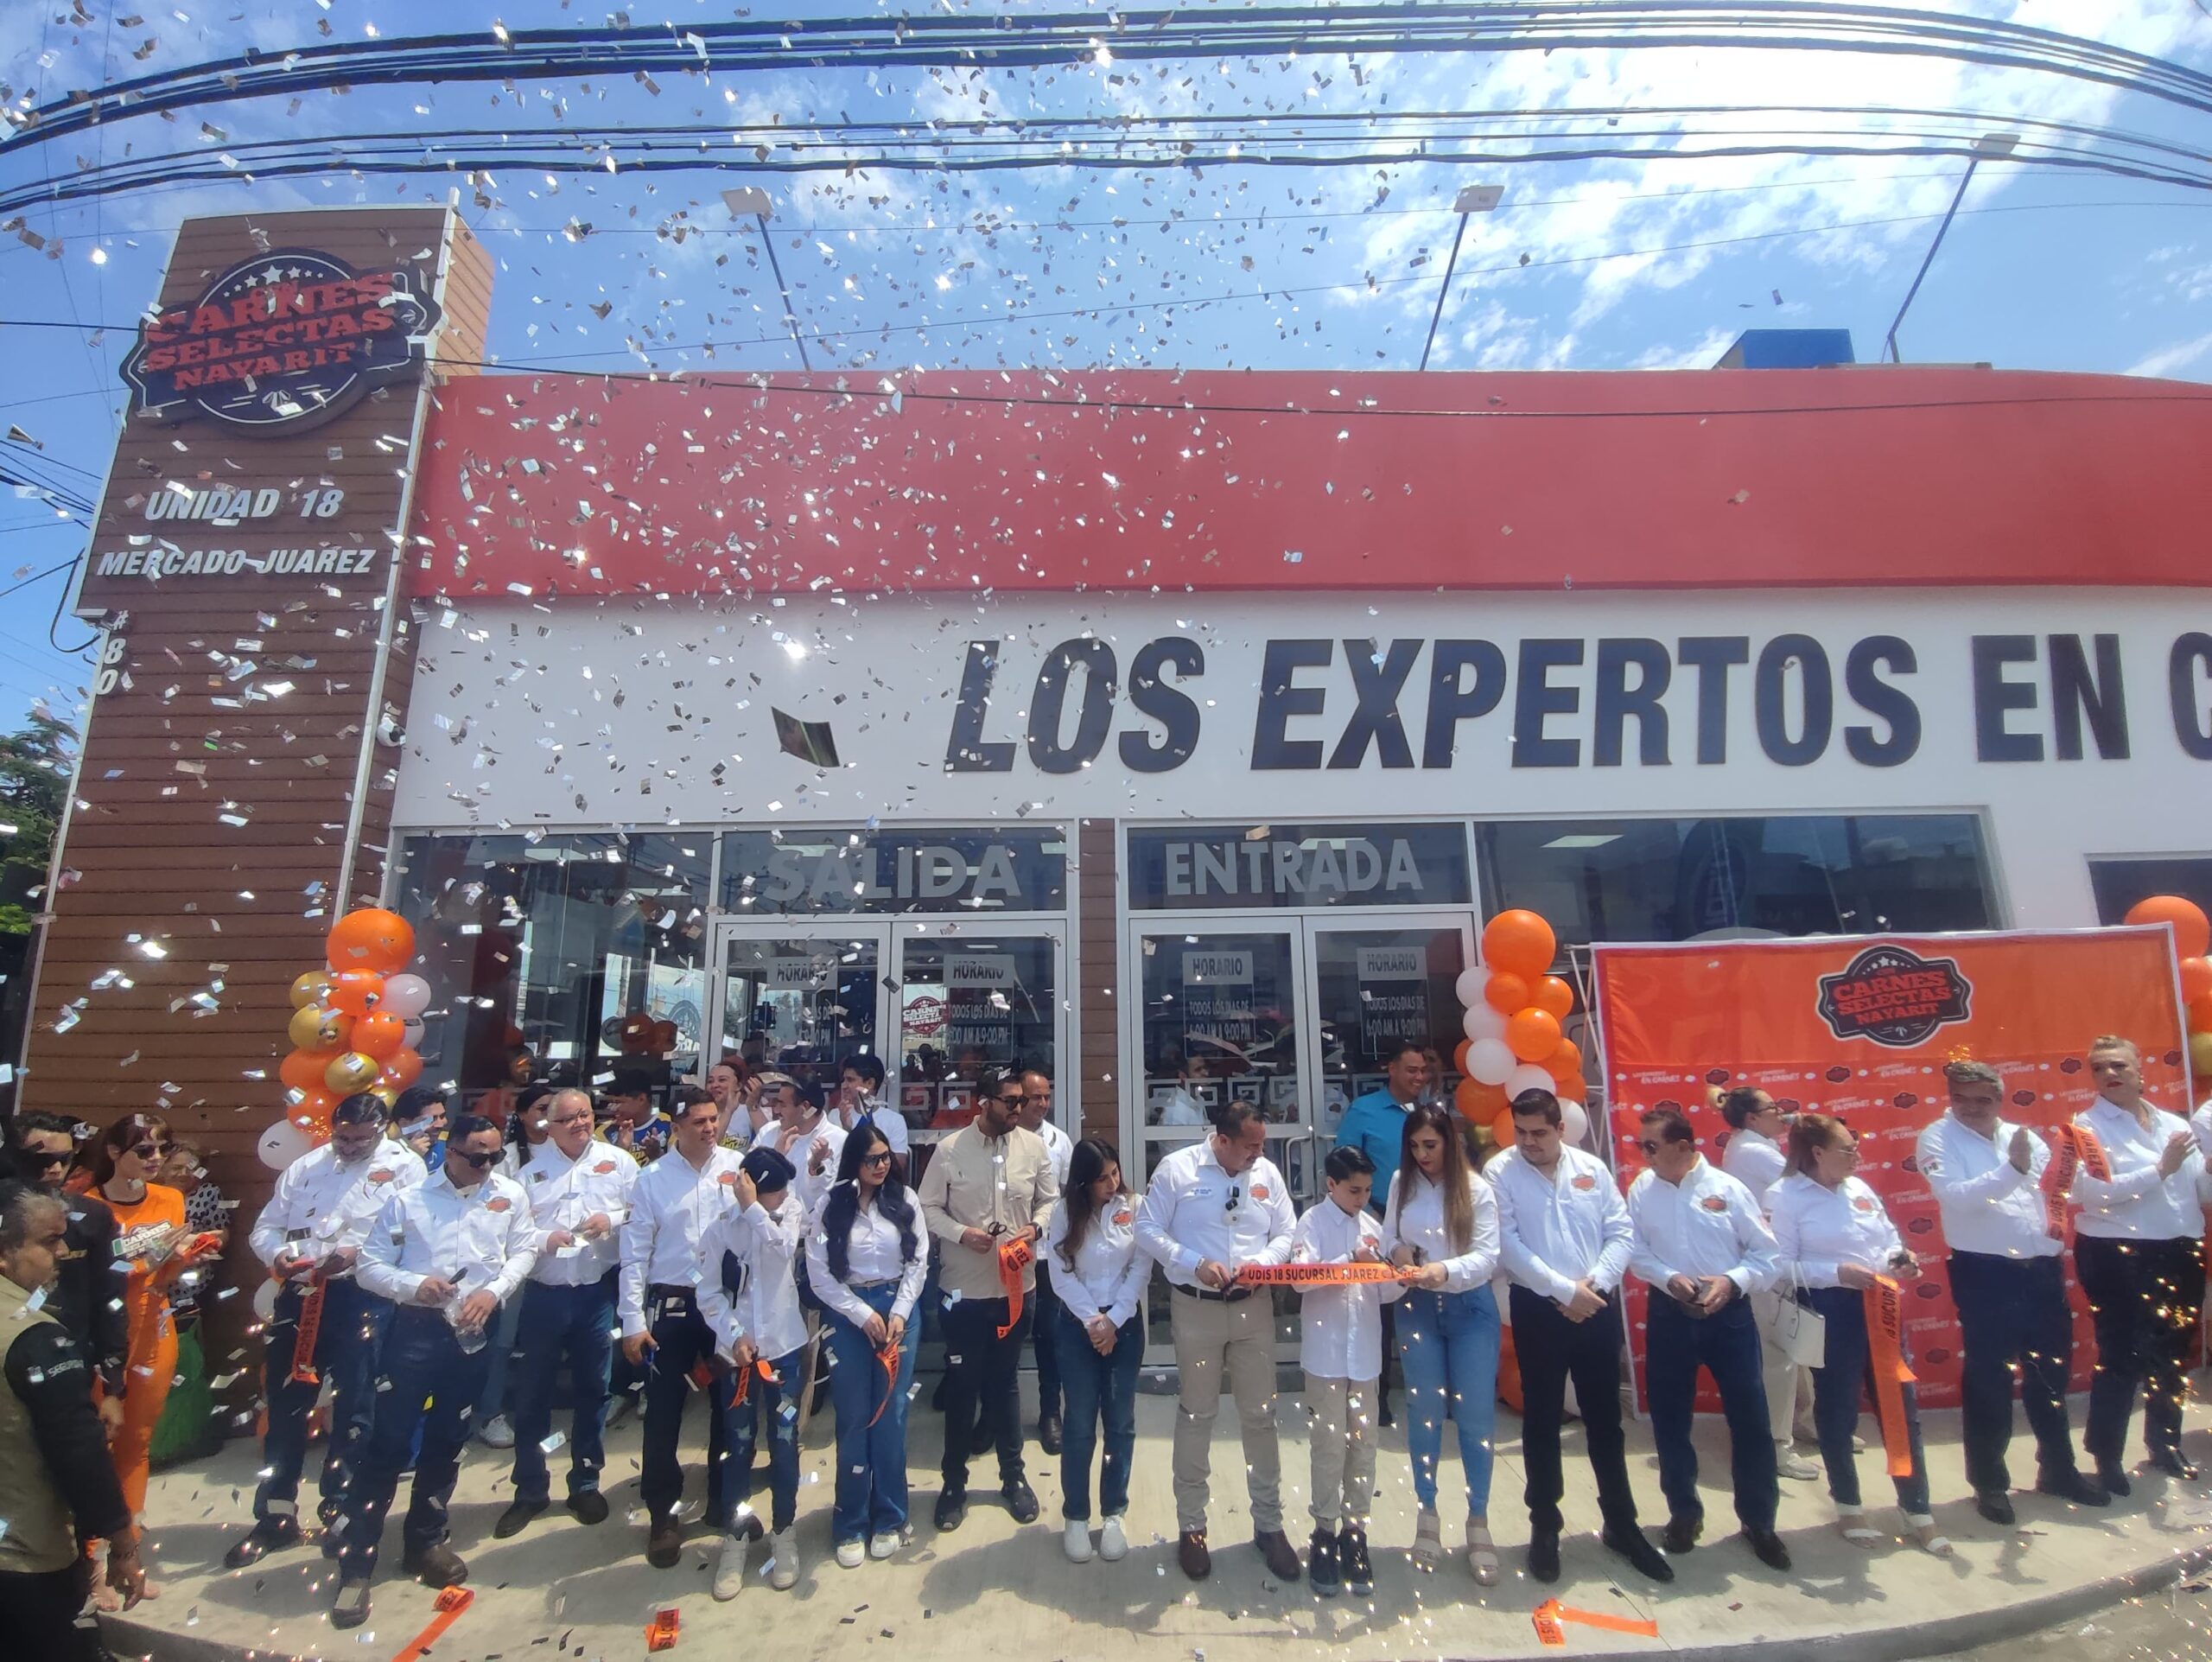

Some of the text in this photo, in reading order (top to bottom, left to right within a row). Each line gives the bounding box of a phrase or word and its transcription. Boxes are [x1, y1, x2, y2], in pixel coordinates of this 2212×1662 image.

[147, 272, 395, 343] CARNES
[145, 308, 397, 372] SELECTAS
[174, 342, 356, 391] NAYARIT
[145, 488, 344, 520] UNIDAD 18
[97, 549, 377, 576] MERCADO JUAREZ
[944, 636, 1205, 774] LOS
[1251, 633, 1922, 769] EXPERTOS
[1972, 634, 2131, 762] EN
[763, 844, 1021, 901] SALIDA
[1166, 838, 1424, 896] ENTRADA
[953, 961, 1004, 979] HORARIO
[1193, 958, 1243, 977] HORARIO
[1368, 953, 1418, 972] HORARIO
[1833, 971, 1948, 1001] CARNES
[1190, 1001, 1211, 1016] TODOS
[1837, 987, 1952, 1016] SELECTAS
[1855, 1003, 1939, 1025] NAYARIT
[1248, 1268, 1271, 1281] UDIS
[1274, 1268, 1283, 1280] 18
[1286, 1267, 1338, 1281] SUCURSAL
[1341, 1267, 1378, 1280] JUAREZ
